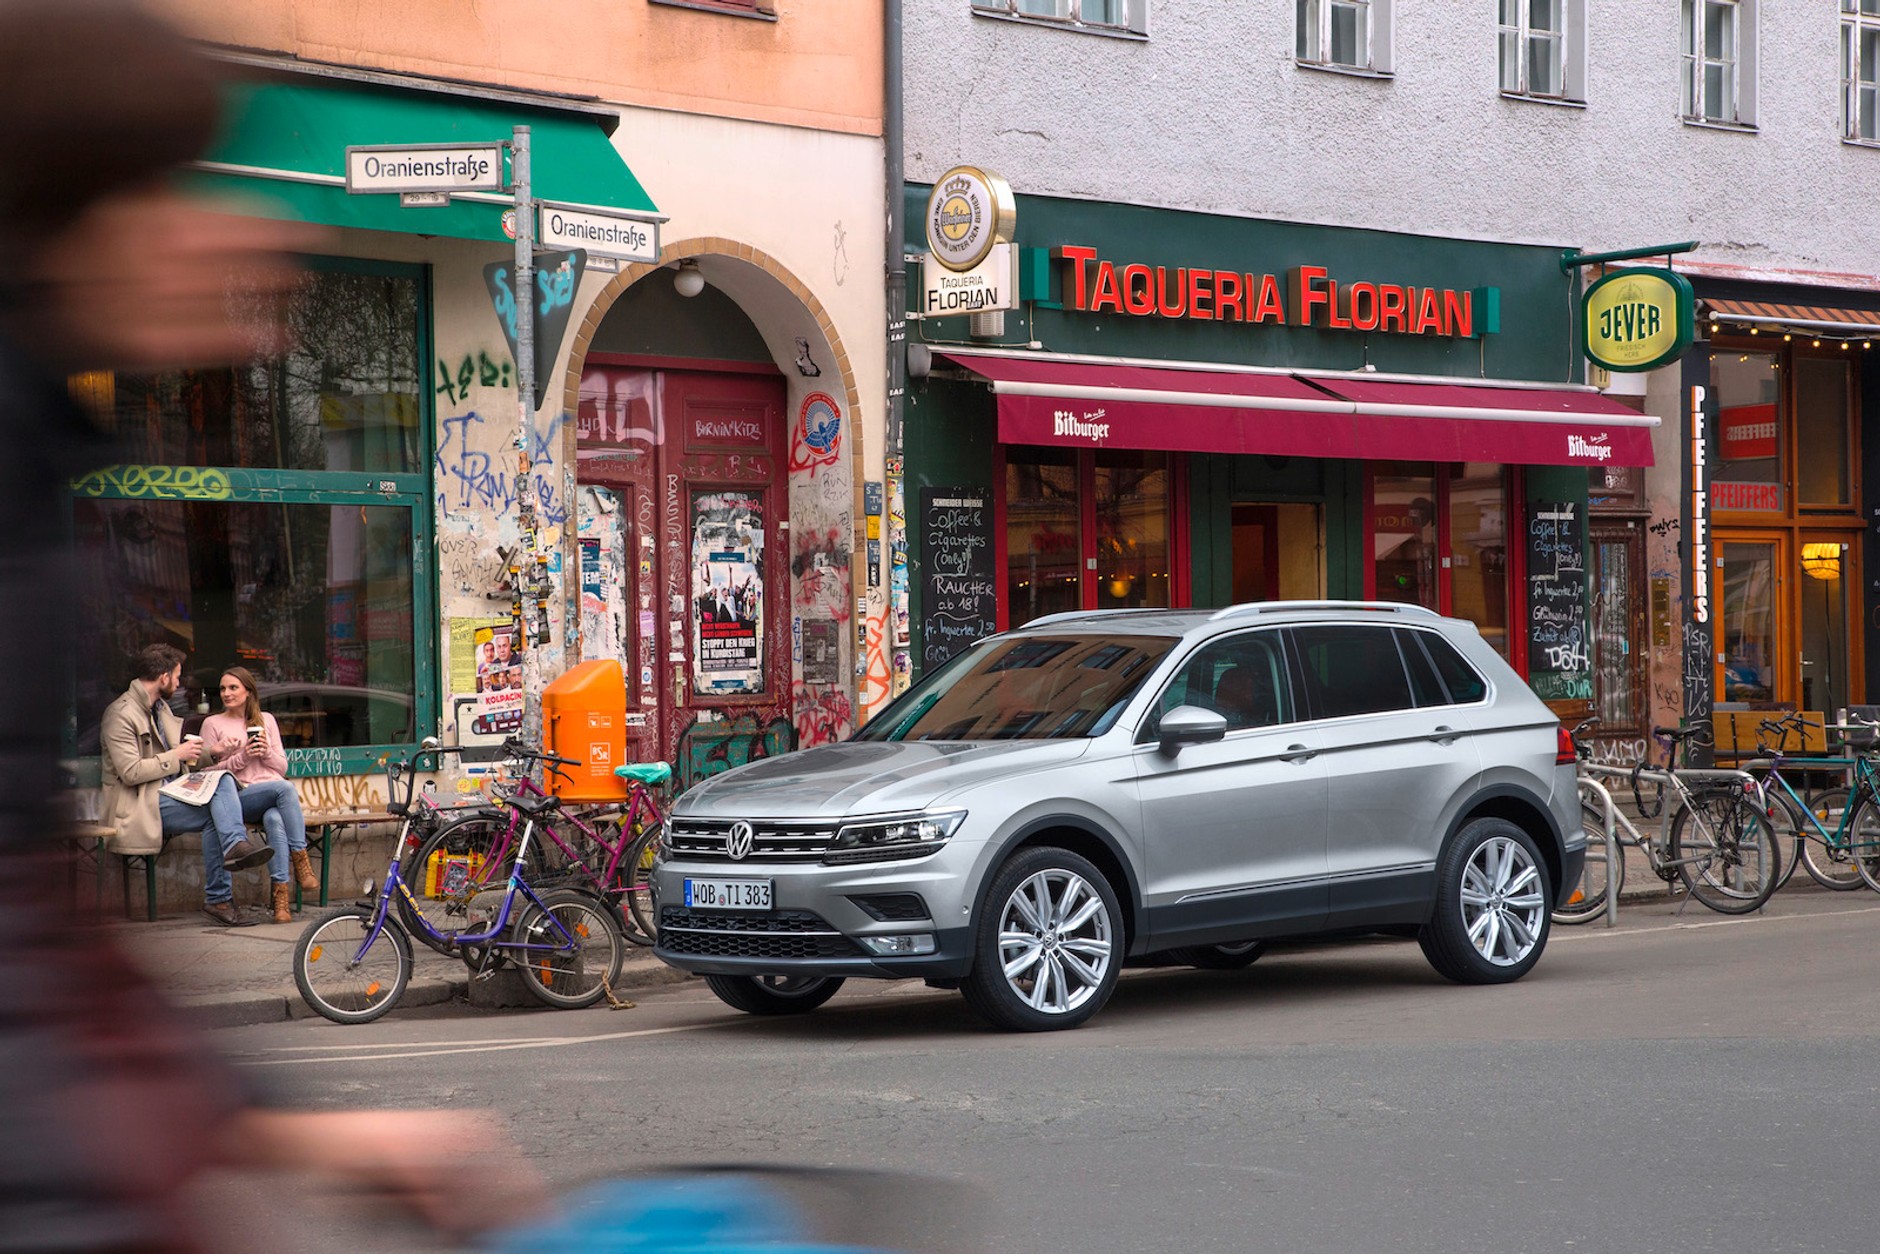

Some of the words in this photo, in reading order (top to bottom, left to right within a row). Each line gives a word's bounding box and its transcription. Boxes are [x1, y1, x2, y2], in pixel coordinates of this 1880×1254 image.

[364, 154, 489, 181] Oranienstraße
[550, 213, 647, 251] Oranienstraße
[940, 276, 983, 289] TAQUERIA
[1062, 245, 1286, 326] TAQUERIA
[1300, 264, 1472, 338] FLORIAN
[928, 287, 998, 311] FLORIAN
[890, 321, 905, 330] EAS
[1600, 303, 1661, 342] JEVER
[889, 388, 904, 396] EAS
[1053, 410, 1110, 442] Bitburger
[1567, 434, 1612, 462] Bitburger
[1692, 385, 1708, 623] PFEIFFERS
[1711, 482, 1779, 510] PFEIFFERS
[929, 508, 969, 533] Coffee
[929, 531, 986, 553] Cigarettes
[931, 575, 995, 597] RAUCHER
[938, 598, 954, 610] ab
[959, 596, 980, 613] 18!
[592, 746, 608, 761] BSR
[693, 882, 716, 906] WOB
[725, 884, 741, 906] TI
[744, 884, 771, 907] 383
